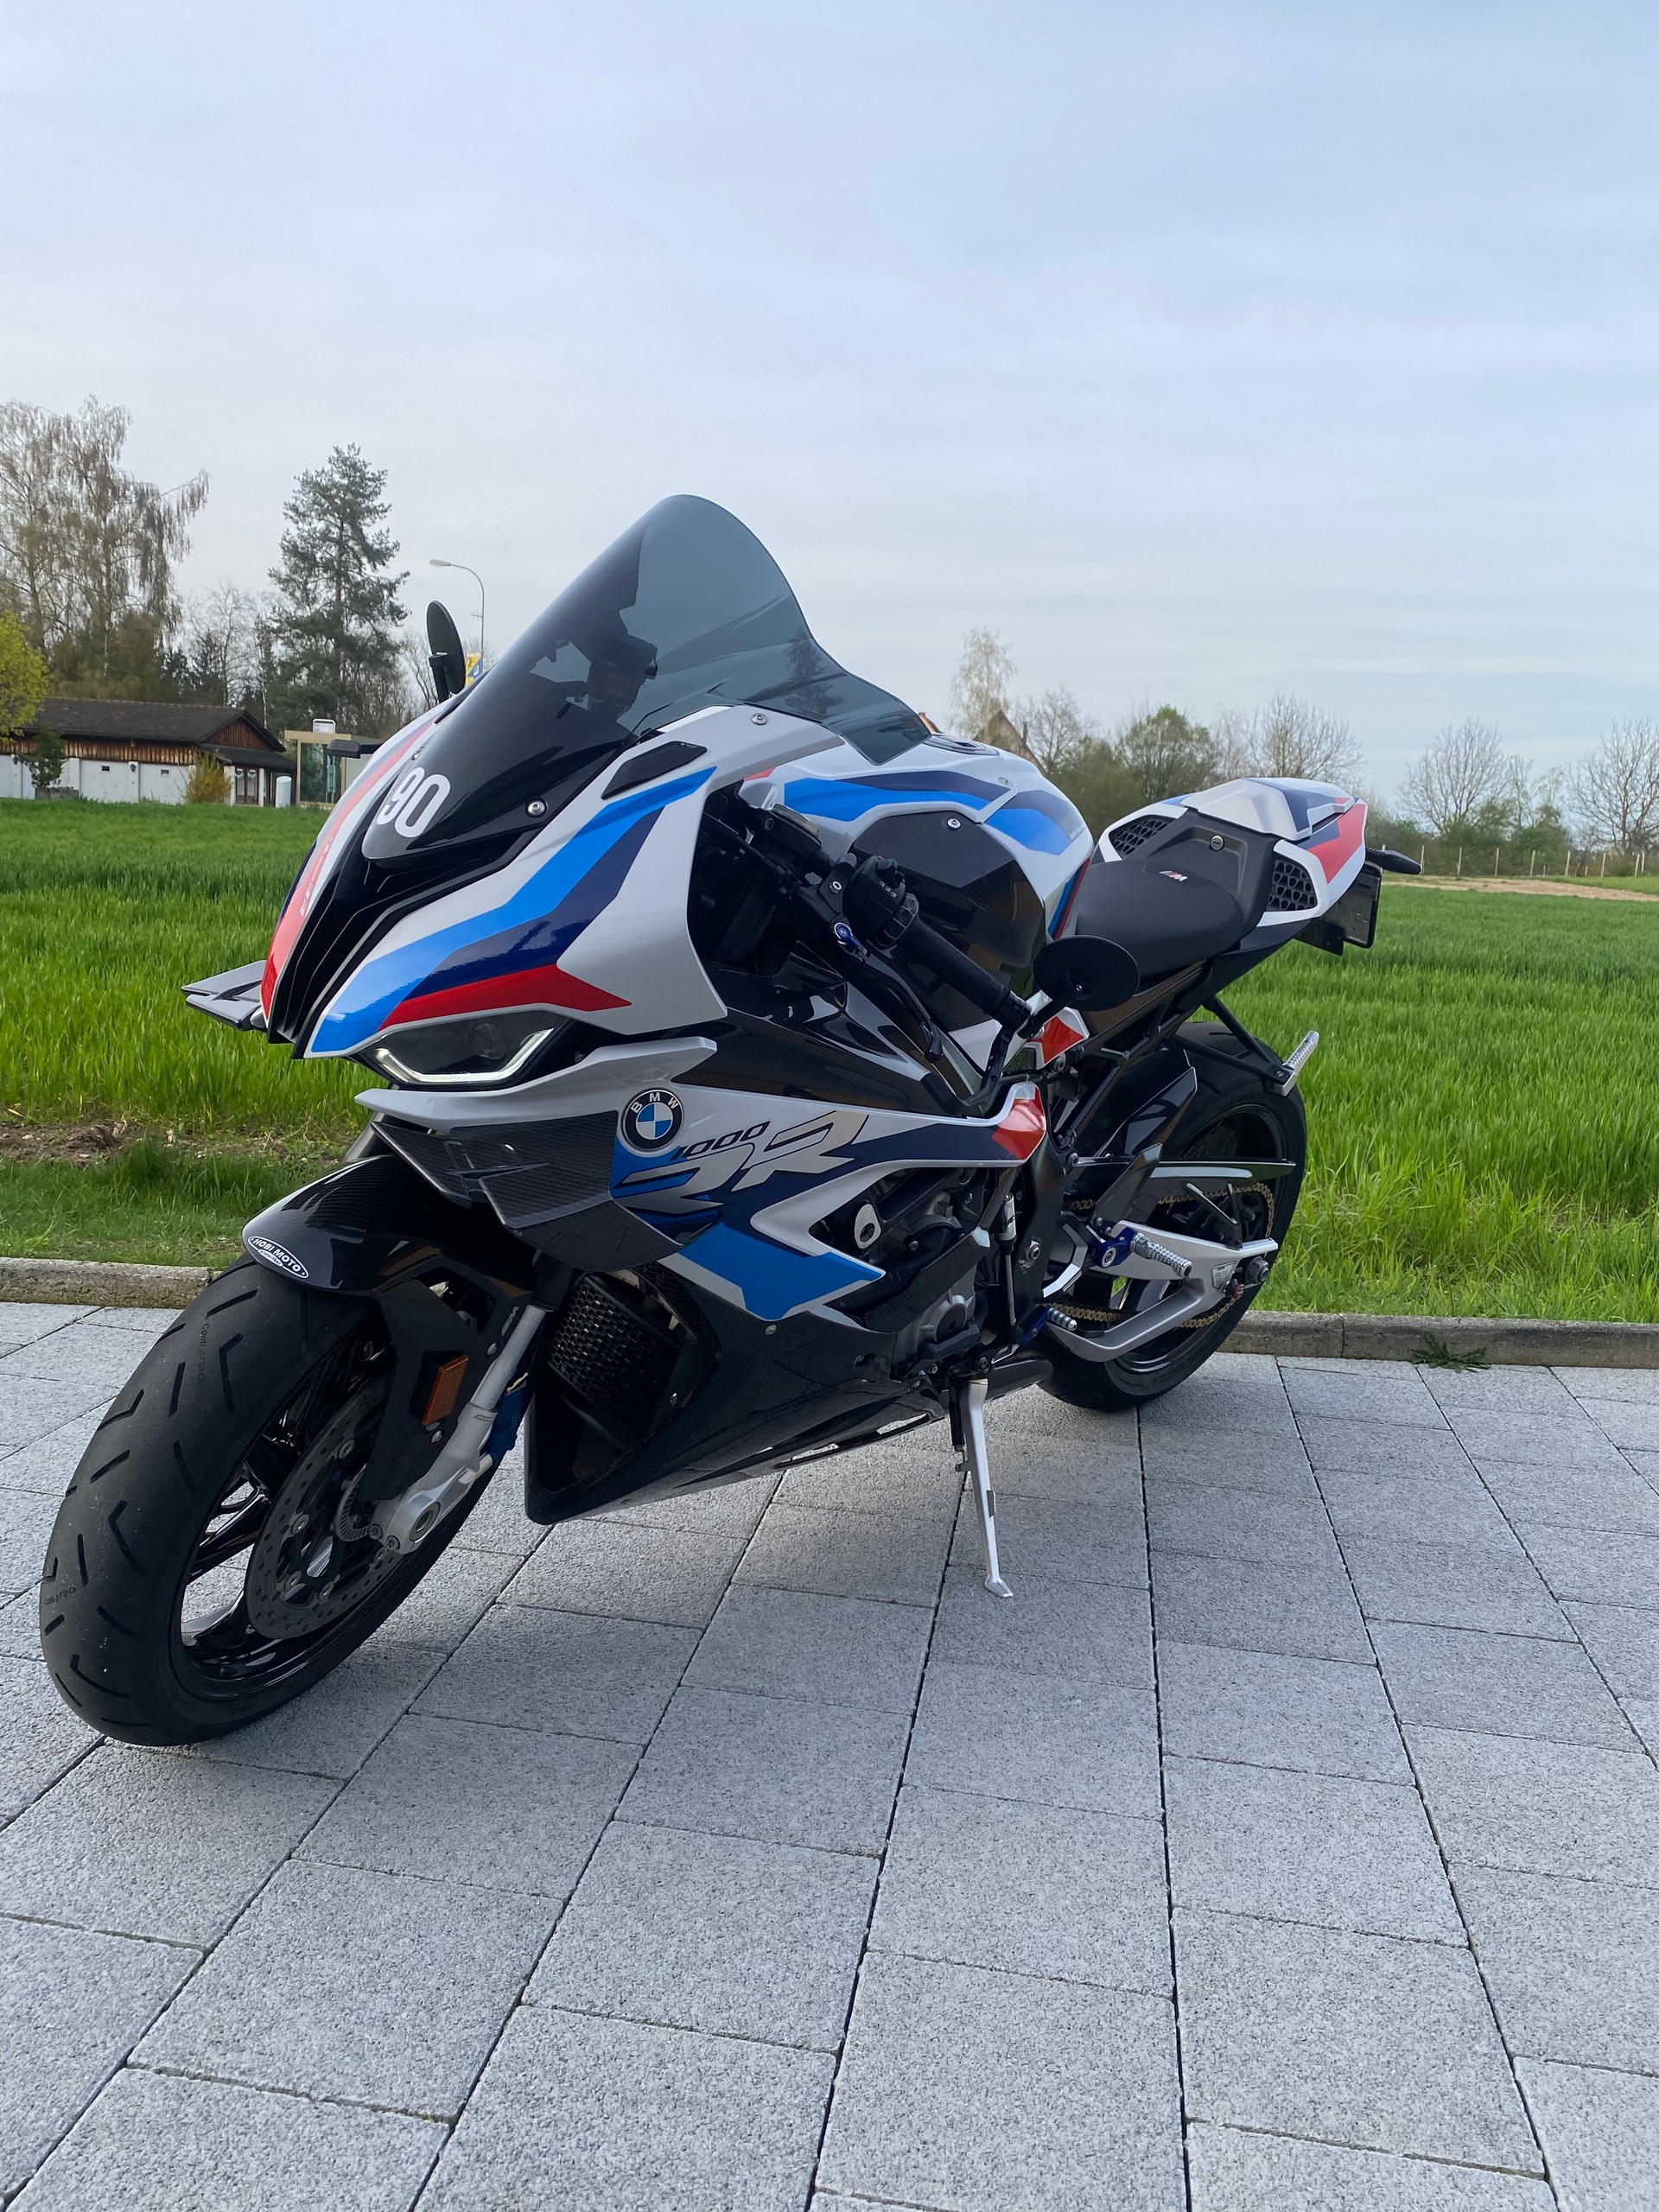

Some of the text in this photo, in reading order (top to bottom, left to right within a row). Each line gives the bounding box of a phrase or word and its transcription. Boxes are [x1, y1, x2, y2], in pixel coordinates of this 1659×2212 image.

[377, 766, 451, 838] 90
[630, 1091, 680, 1114] BMW
[669, 1121, 771, 1161] 1000
[252, 1238, 275, 1252] HOBI
[273, 1249, 301, 1272] MOTO
